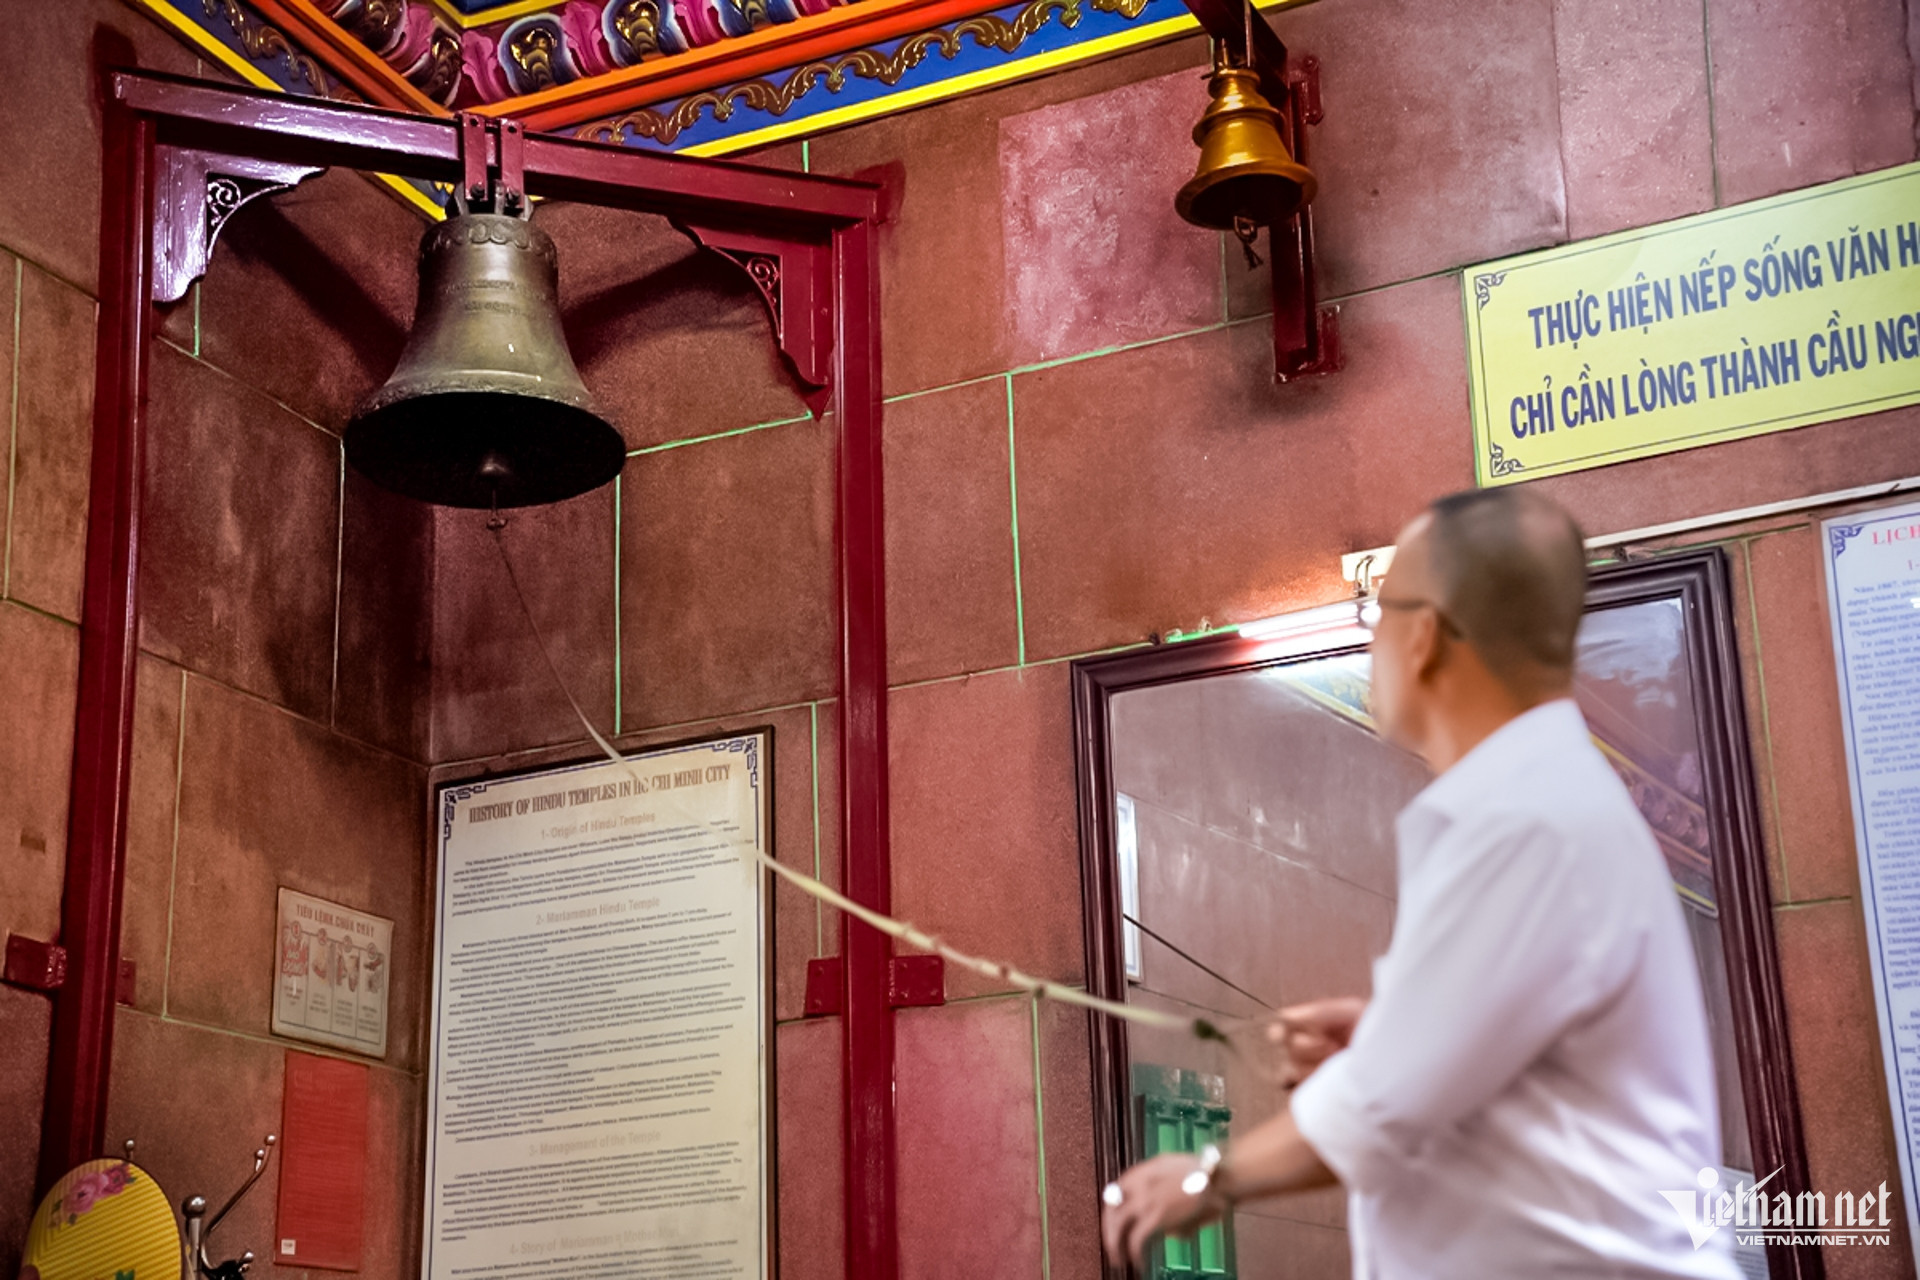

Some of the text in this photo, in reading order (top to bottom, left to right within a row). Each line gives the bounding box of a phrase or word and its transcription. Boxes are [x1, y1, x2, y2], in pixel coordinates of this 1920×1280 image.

[1528, 222, 1920, 350] THỰC HIỆN NẾP SỐNG VĂN H
[1509, 310, 1920, 439] CHỈ CẦN LÒNG THÀNH CẦU NG
[469, 800, 514, 823] HISTORY
[516, 798, 530, 815] OF
[532, 791, 566, 814] HINDU
[568, 783, 617, 807] TEMPLES
[619, 780, 631, 798] IN
[673, 768, 703, 789] MINH
[705, 763, 731, 784] CITY
